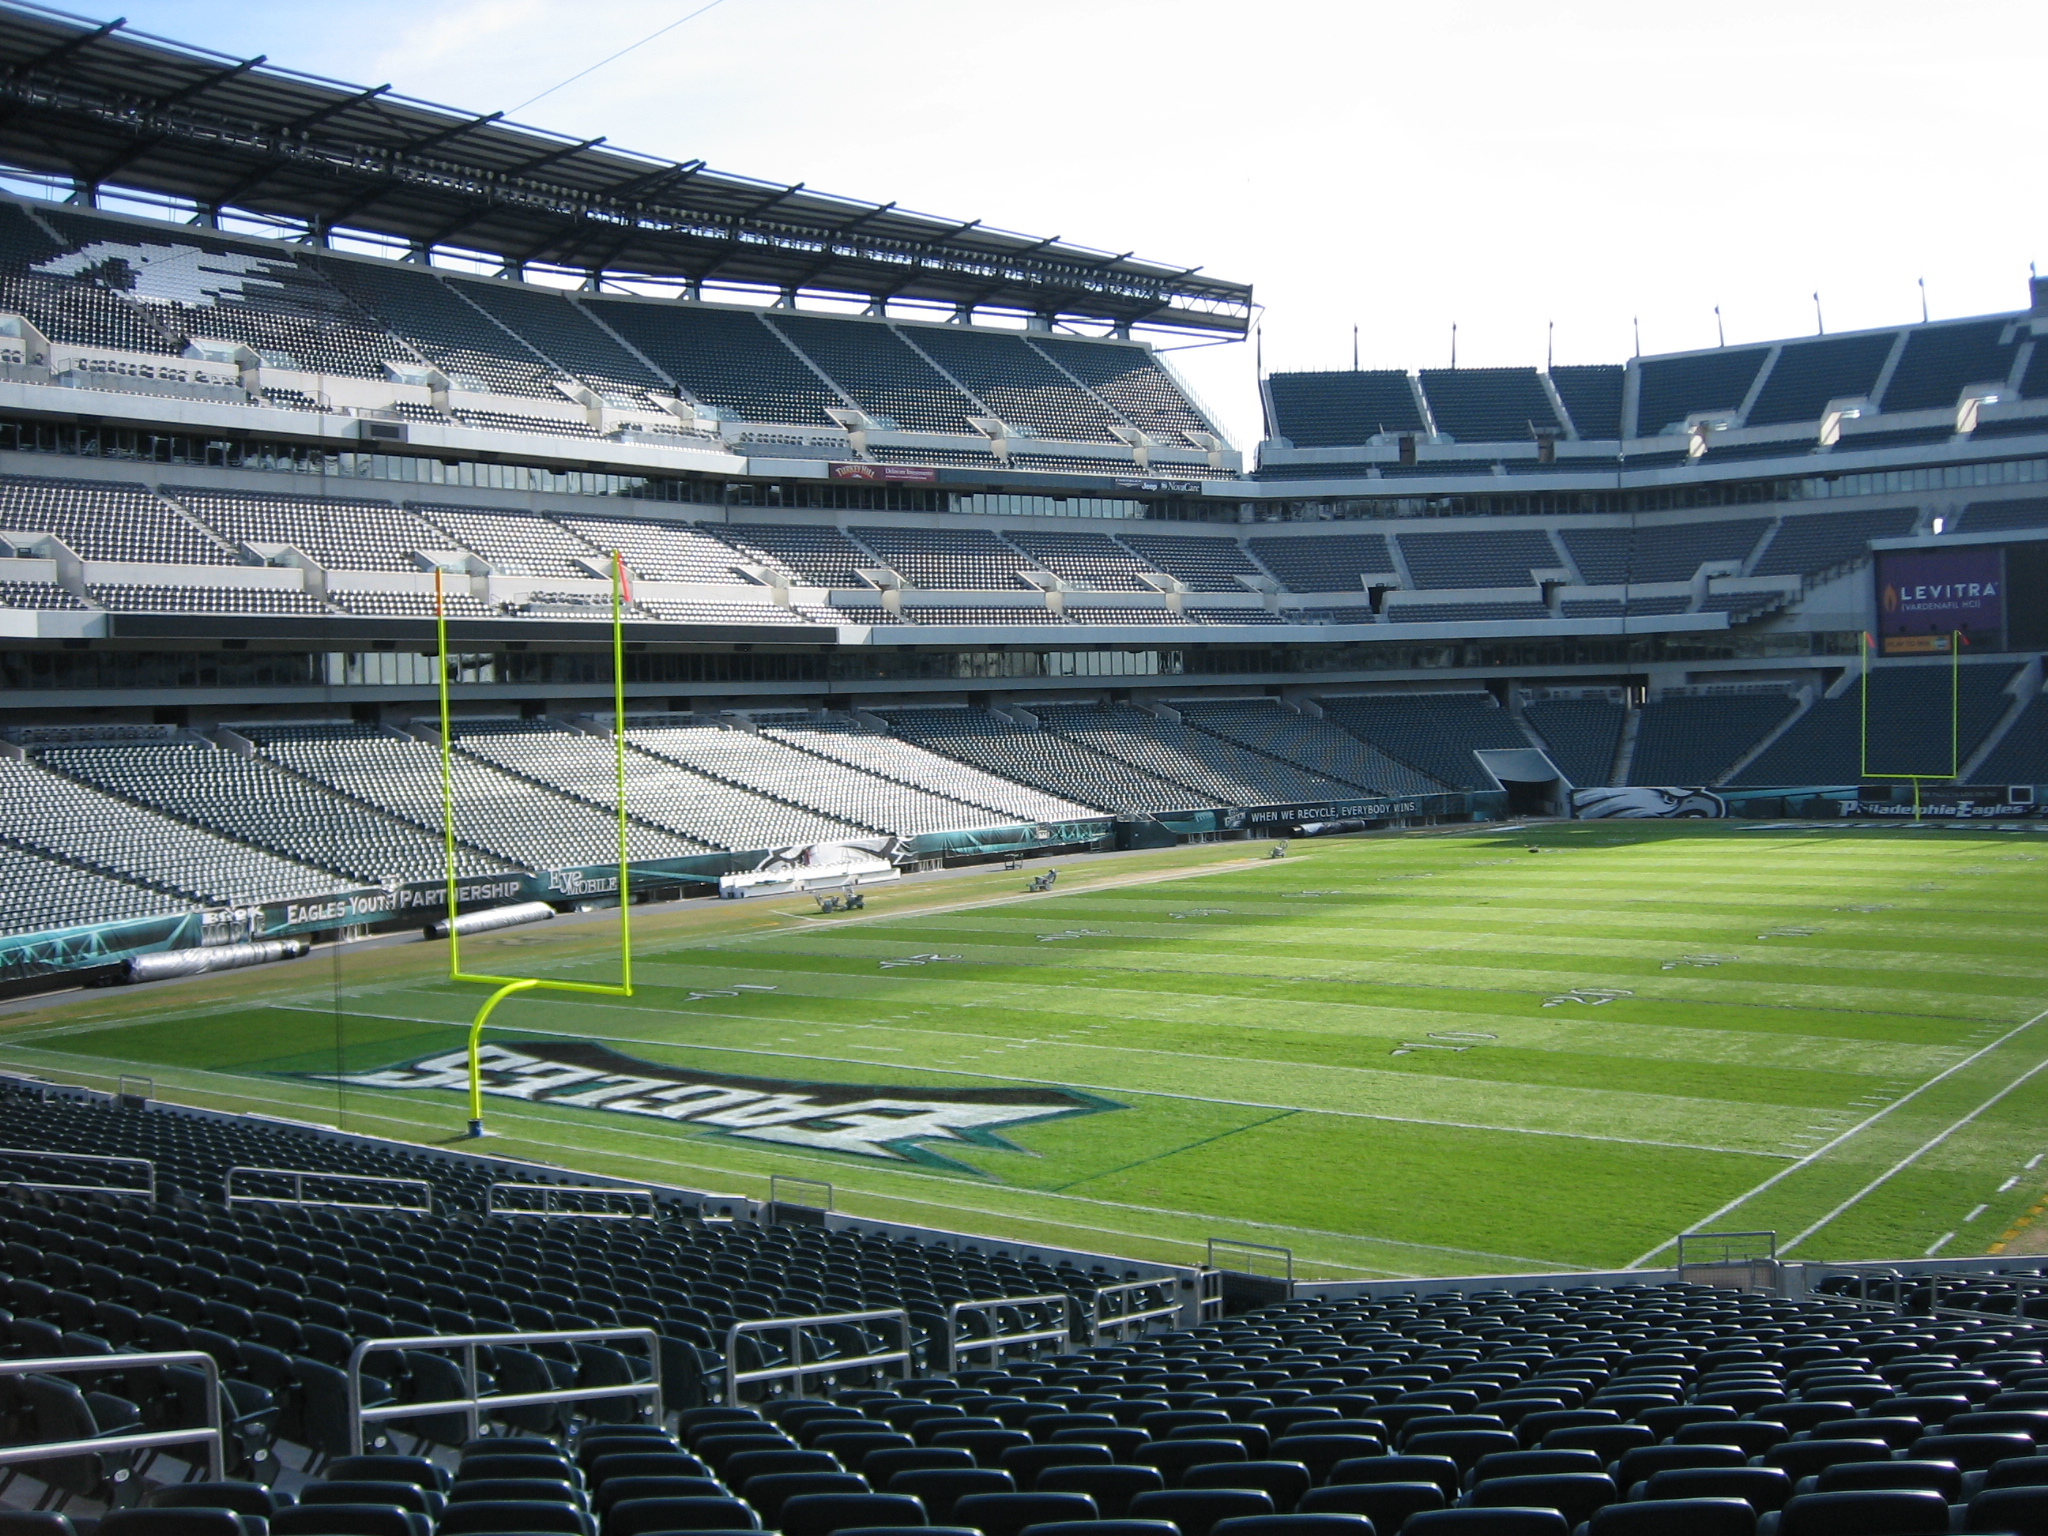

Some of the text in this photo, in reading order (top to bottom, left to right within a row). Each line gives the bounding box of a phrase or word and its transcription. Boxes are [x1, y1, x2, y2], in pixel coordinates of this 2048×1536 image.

[835, 464, 861, 477] TURKEY
[861, 465, 876, 479] HILL
[1141, 482, 1158, 492] Jeep
[1167, 481, 1200, 492] NovaCare
[1901, 582, 1996, 601] LEVITRA
[1251, 801, 1418, 823] WHEN WE RECYCLE, EVERYBODY WINS.
[548, 867, 583, 894] Eye
[566, 876, 618, 896] MOBILE
[287, 901, 346, 925] EAGLES
[349, 892, 396, 916] YOUTH
[304, 1043, 1091, 1162] EAGLES
